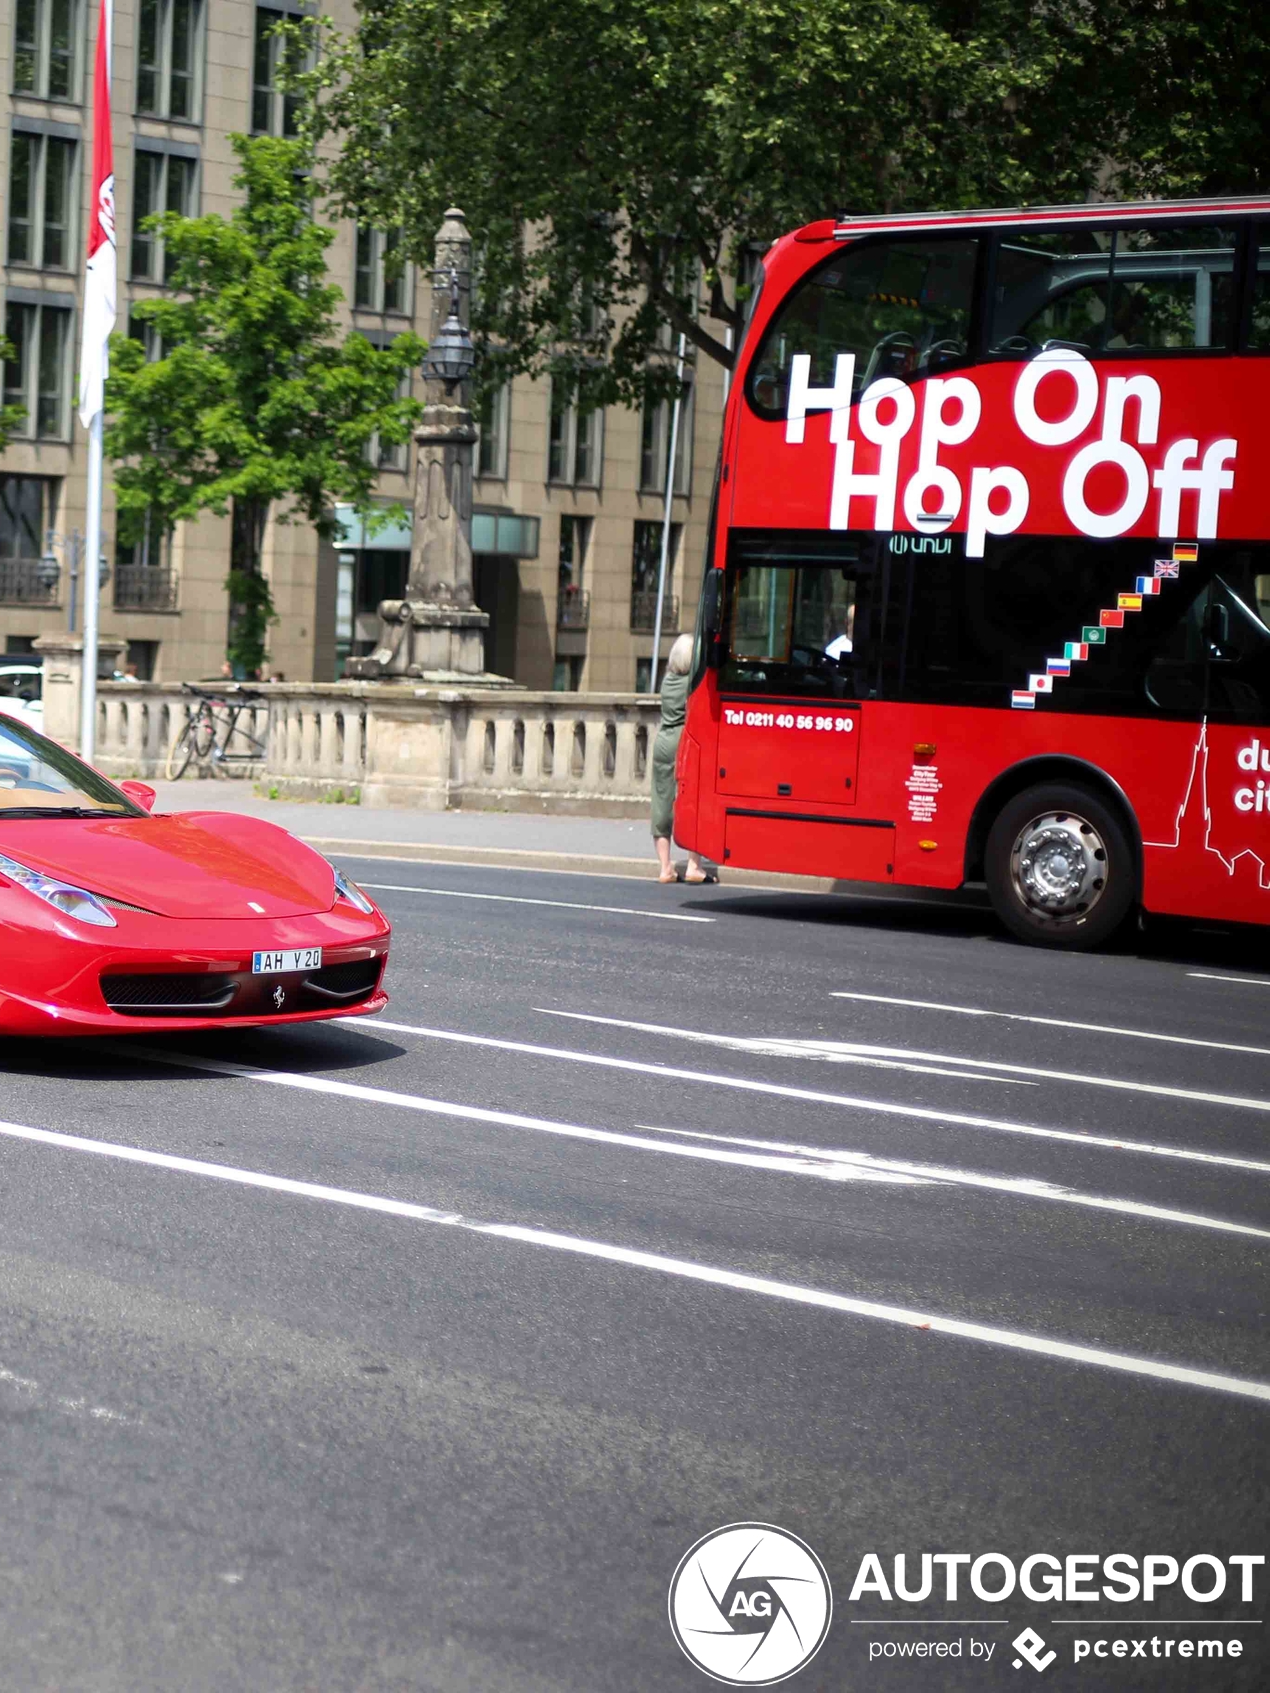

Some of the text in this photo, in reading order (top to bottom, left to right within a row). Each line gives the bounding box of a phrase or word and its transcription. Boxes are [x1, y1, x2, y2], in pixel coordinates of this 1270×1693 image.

[785, 349, 1161, 472] Hop On
[829, 438, 1238, 558] Hop Off
[724, 709, 854, 732] Tel 0211 40 56 96 90
[264, 954, 283, 970] AH
[294, 952, 301, 968] Y
[305, 951, 319, 967] 20
